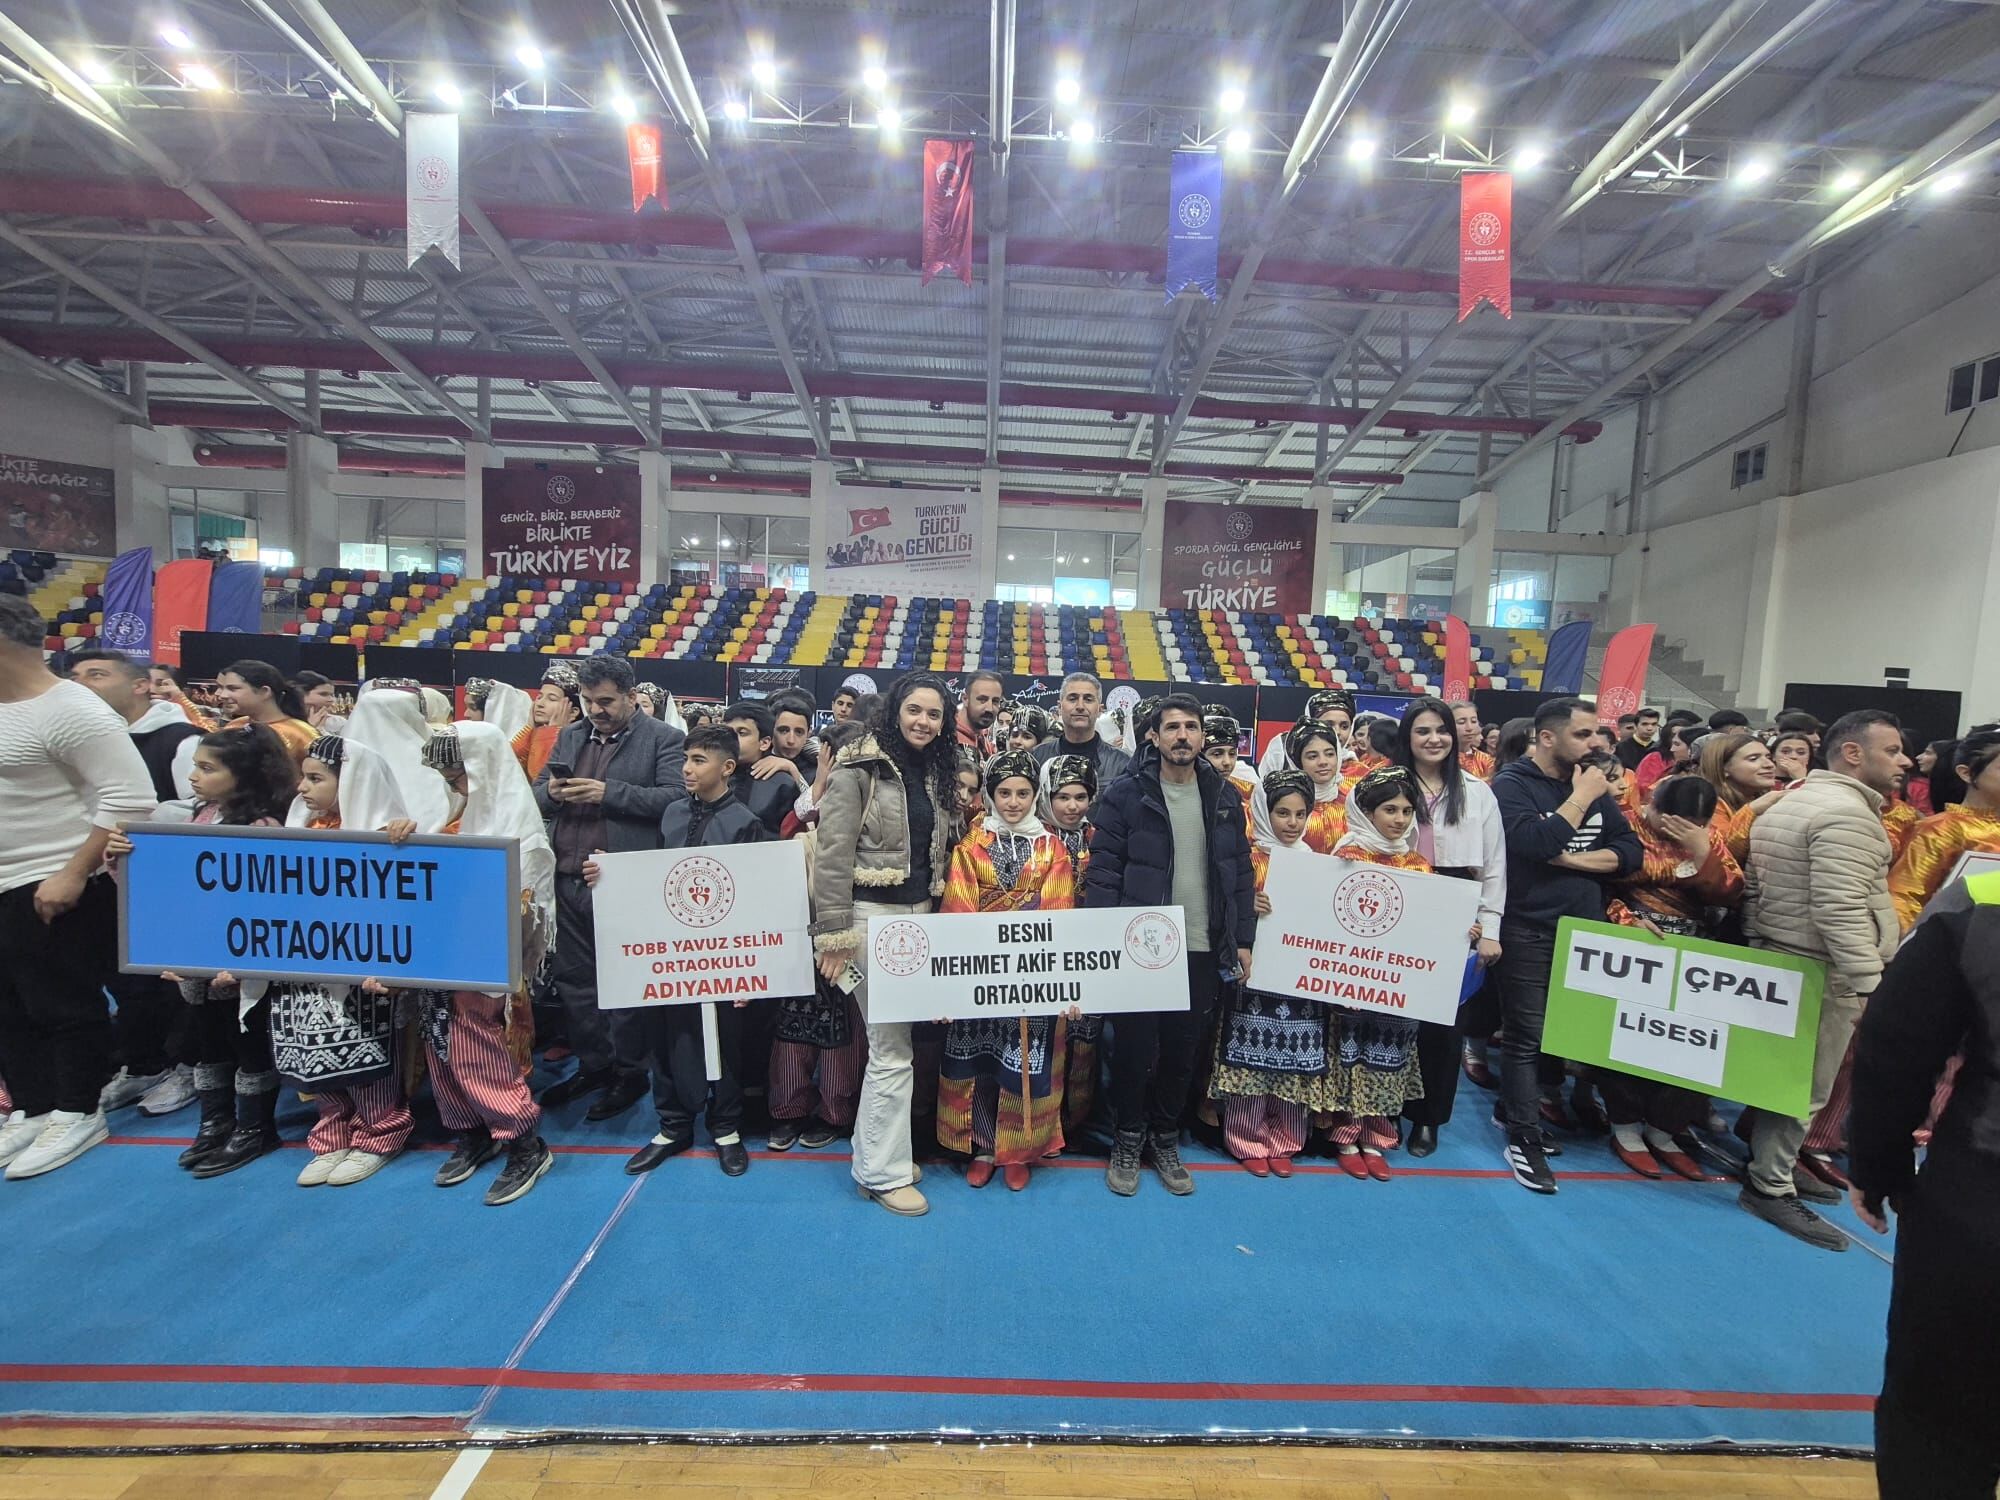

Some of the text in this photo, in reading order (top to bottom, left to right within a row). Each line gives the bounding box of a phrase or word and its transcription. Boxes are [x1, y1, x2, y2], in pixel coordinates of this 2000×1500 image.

[500, 506, 622, 523] GENCİZ, BİRİZ, BERABERİZ
[526, 522, 592, 543] BİRLİKTE
[490, 542, 632, 576] TÜRKİYE'YİZ
[1174, 544, 1210, 555] SPORDA
[1202, 552, 1272, 580] GÜÇLÜ
[1182, 581, 1277, 612] TÜRKİYE
[195, 850, 439, 902] CUMHURİYET
[226, 917, 412, 965] ORTAOKULU
[621, 931, 784, 957] TOBB YAVUZ SELİM
[998, 918, 1053, 943] BESNİ
[652, 954, 757, 974] ORTAOKULU
[931, 948, 1122, 977] MEHMET AKİF ERSOY
[1282, 933, 1437, 972] MEHMET AKİF ERSOY
[1309, 957, 1402, 984] ORTAOKULU
[1574, 946, 1789, 1006] TUT ÇPAL
[642, 975, 769, 1000] ADIYAMAN
[974, 982, 1081, 1006] ORTAOKULU
[1295, 975, 1406, 1009] ADIYAMAN
[1619, 1012, 1719, 1051] LİSESİ
